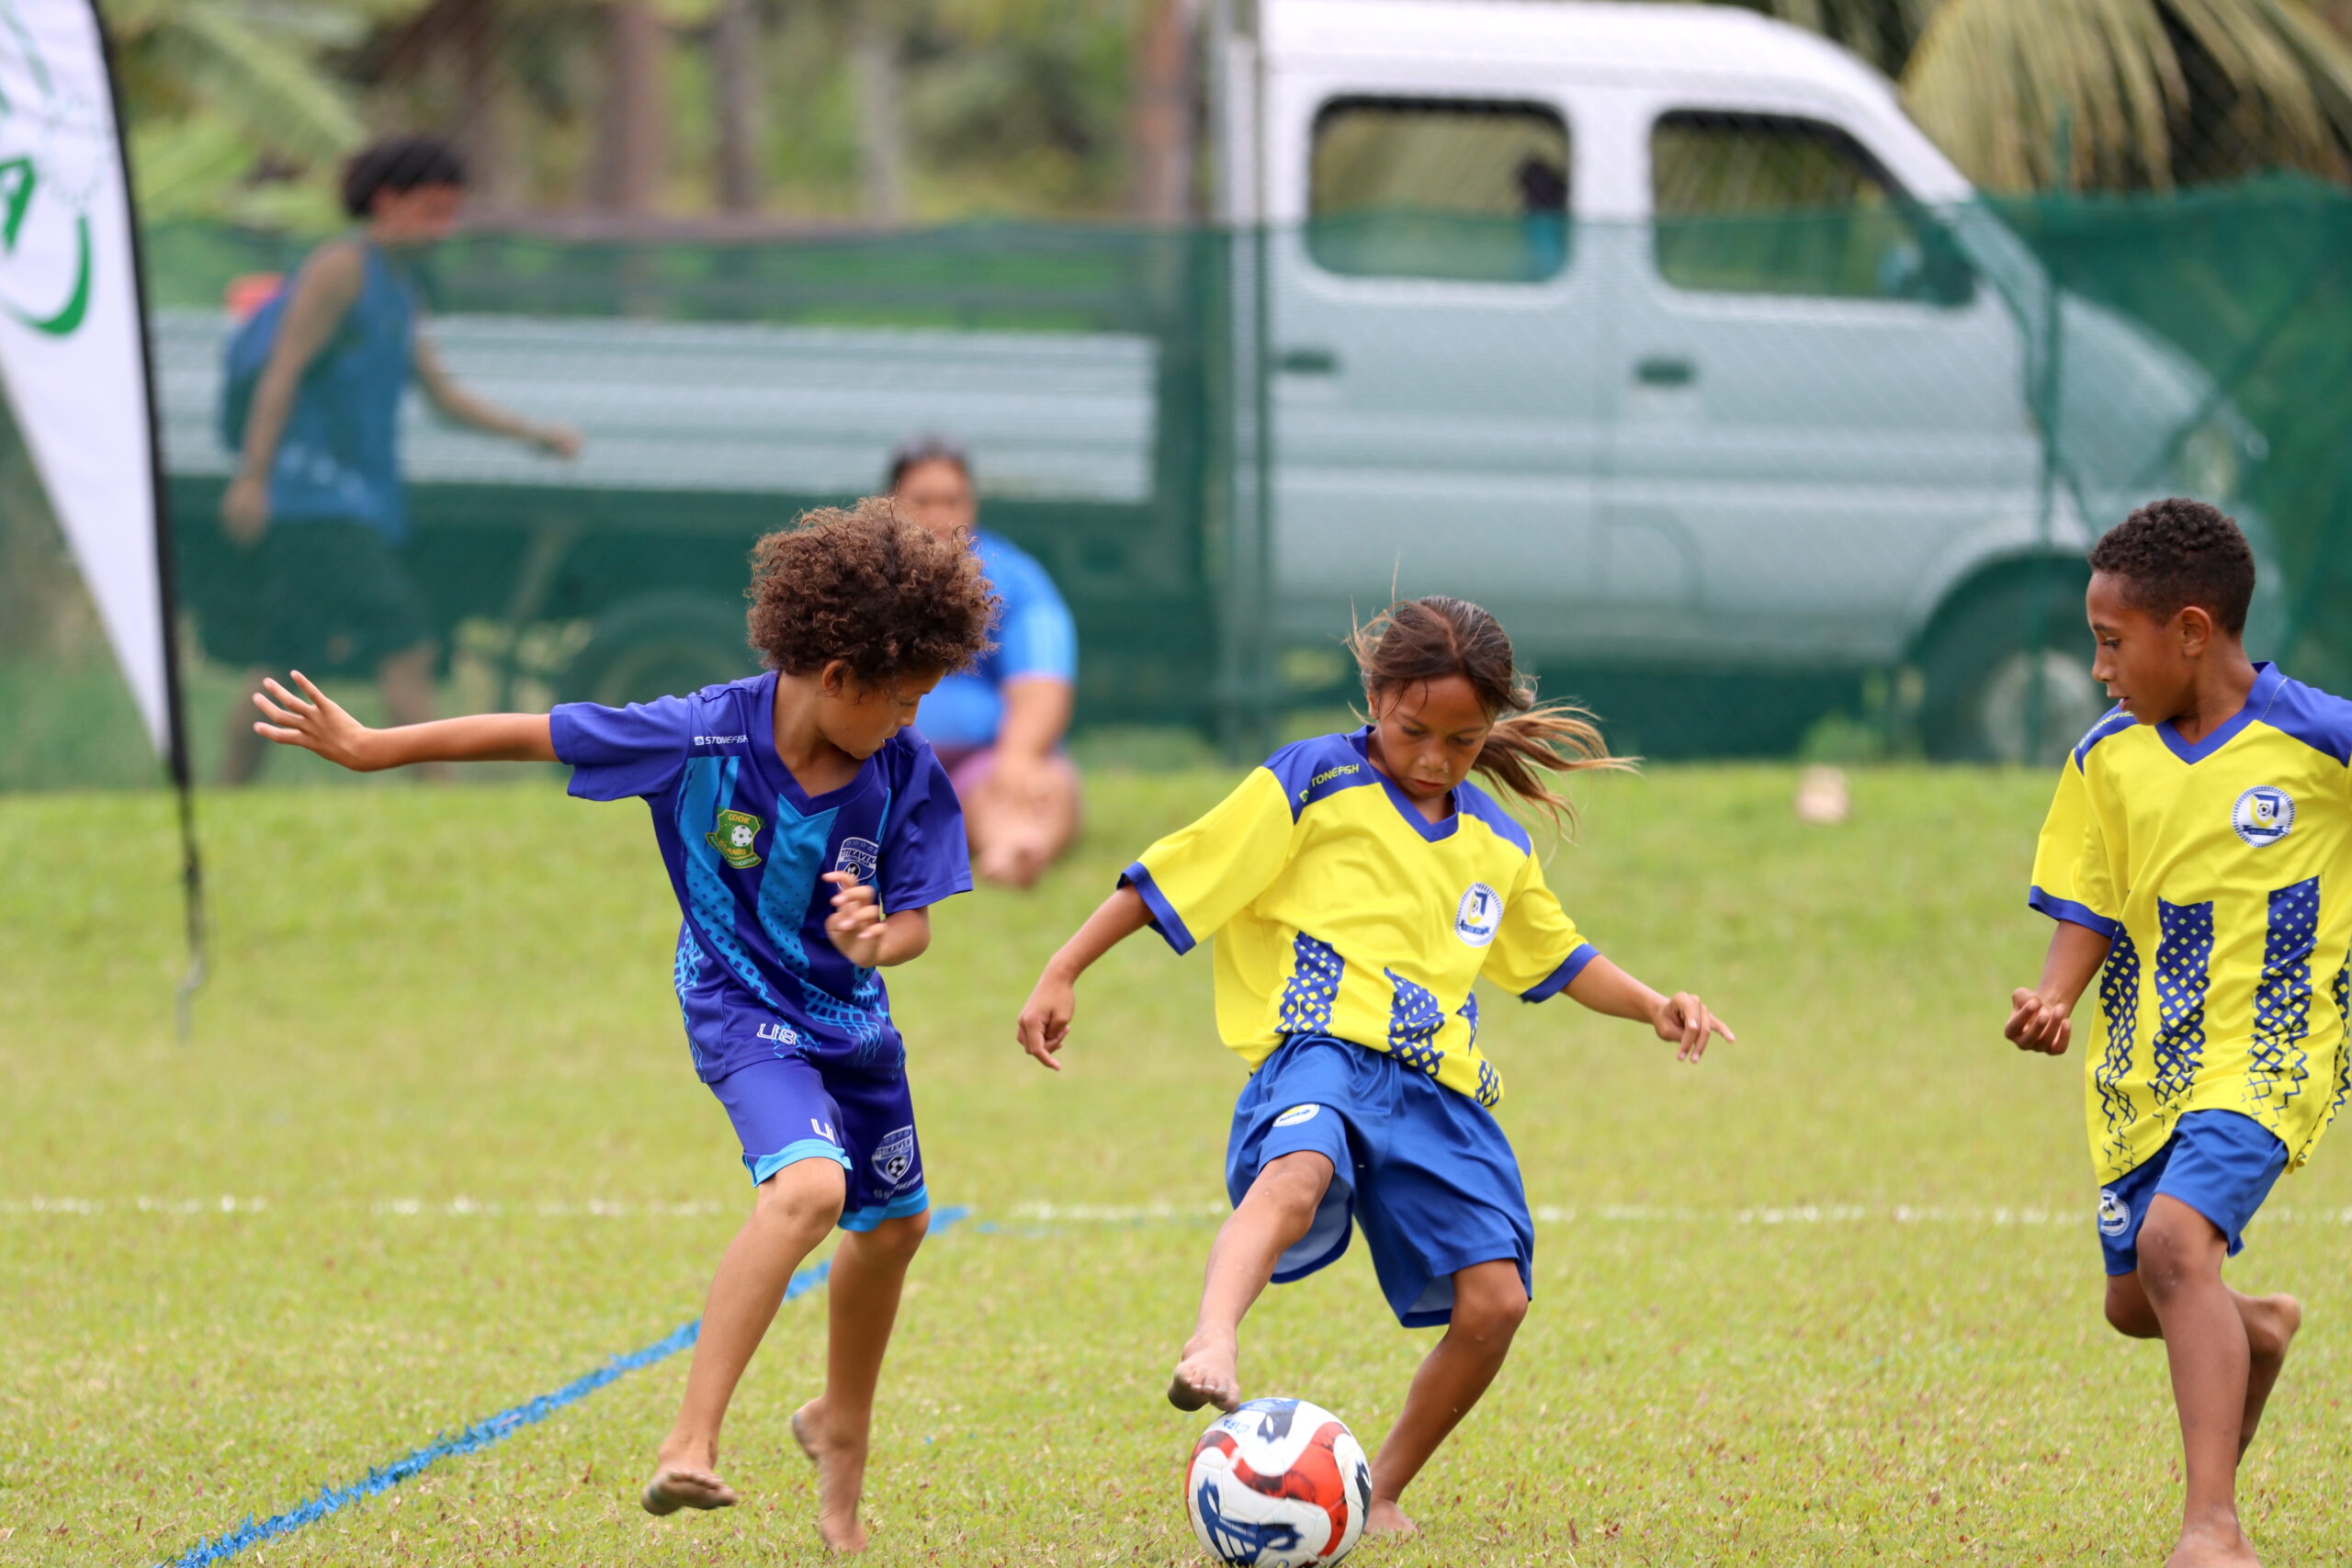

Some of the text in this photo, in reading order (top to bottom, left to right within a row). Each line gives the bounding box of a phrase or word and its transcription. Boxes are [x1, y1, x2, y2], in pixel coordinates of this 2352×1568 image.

[1311, 763, 1360, 787] TONEFSH
[728, 813, 752, 824] COOK
[841, 849, 876, 864] TITIKAVEK
